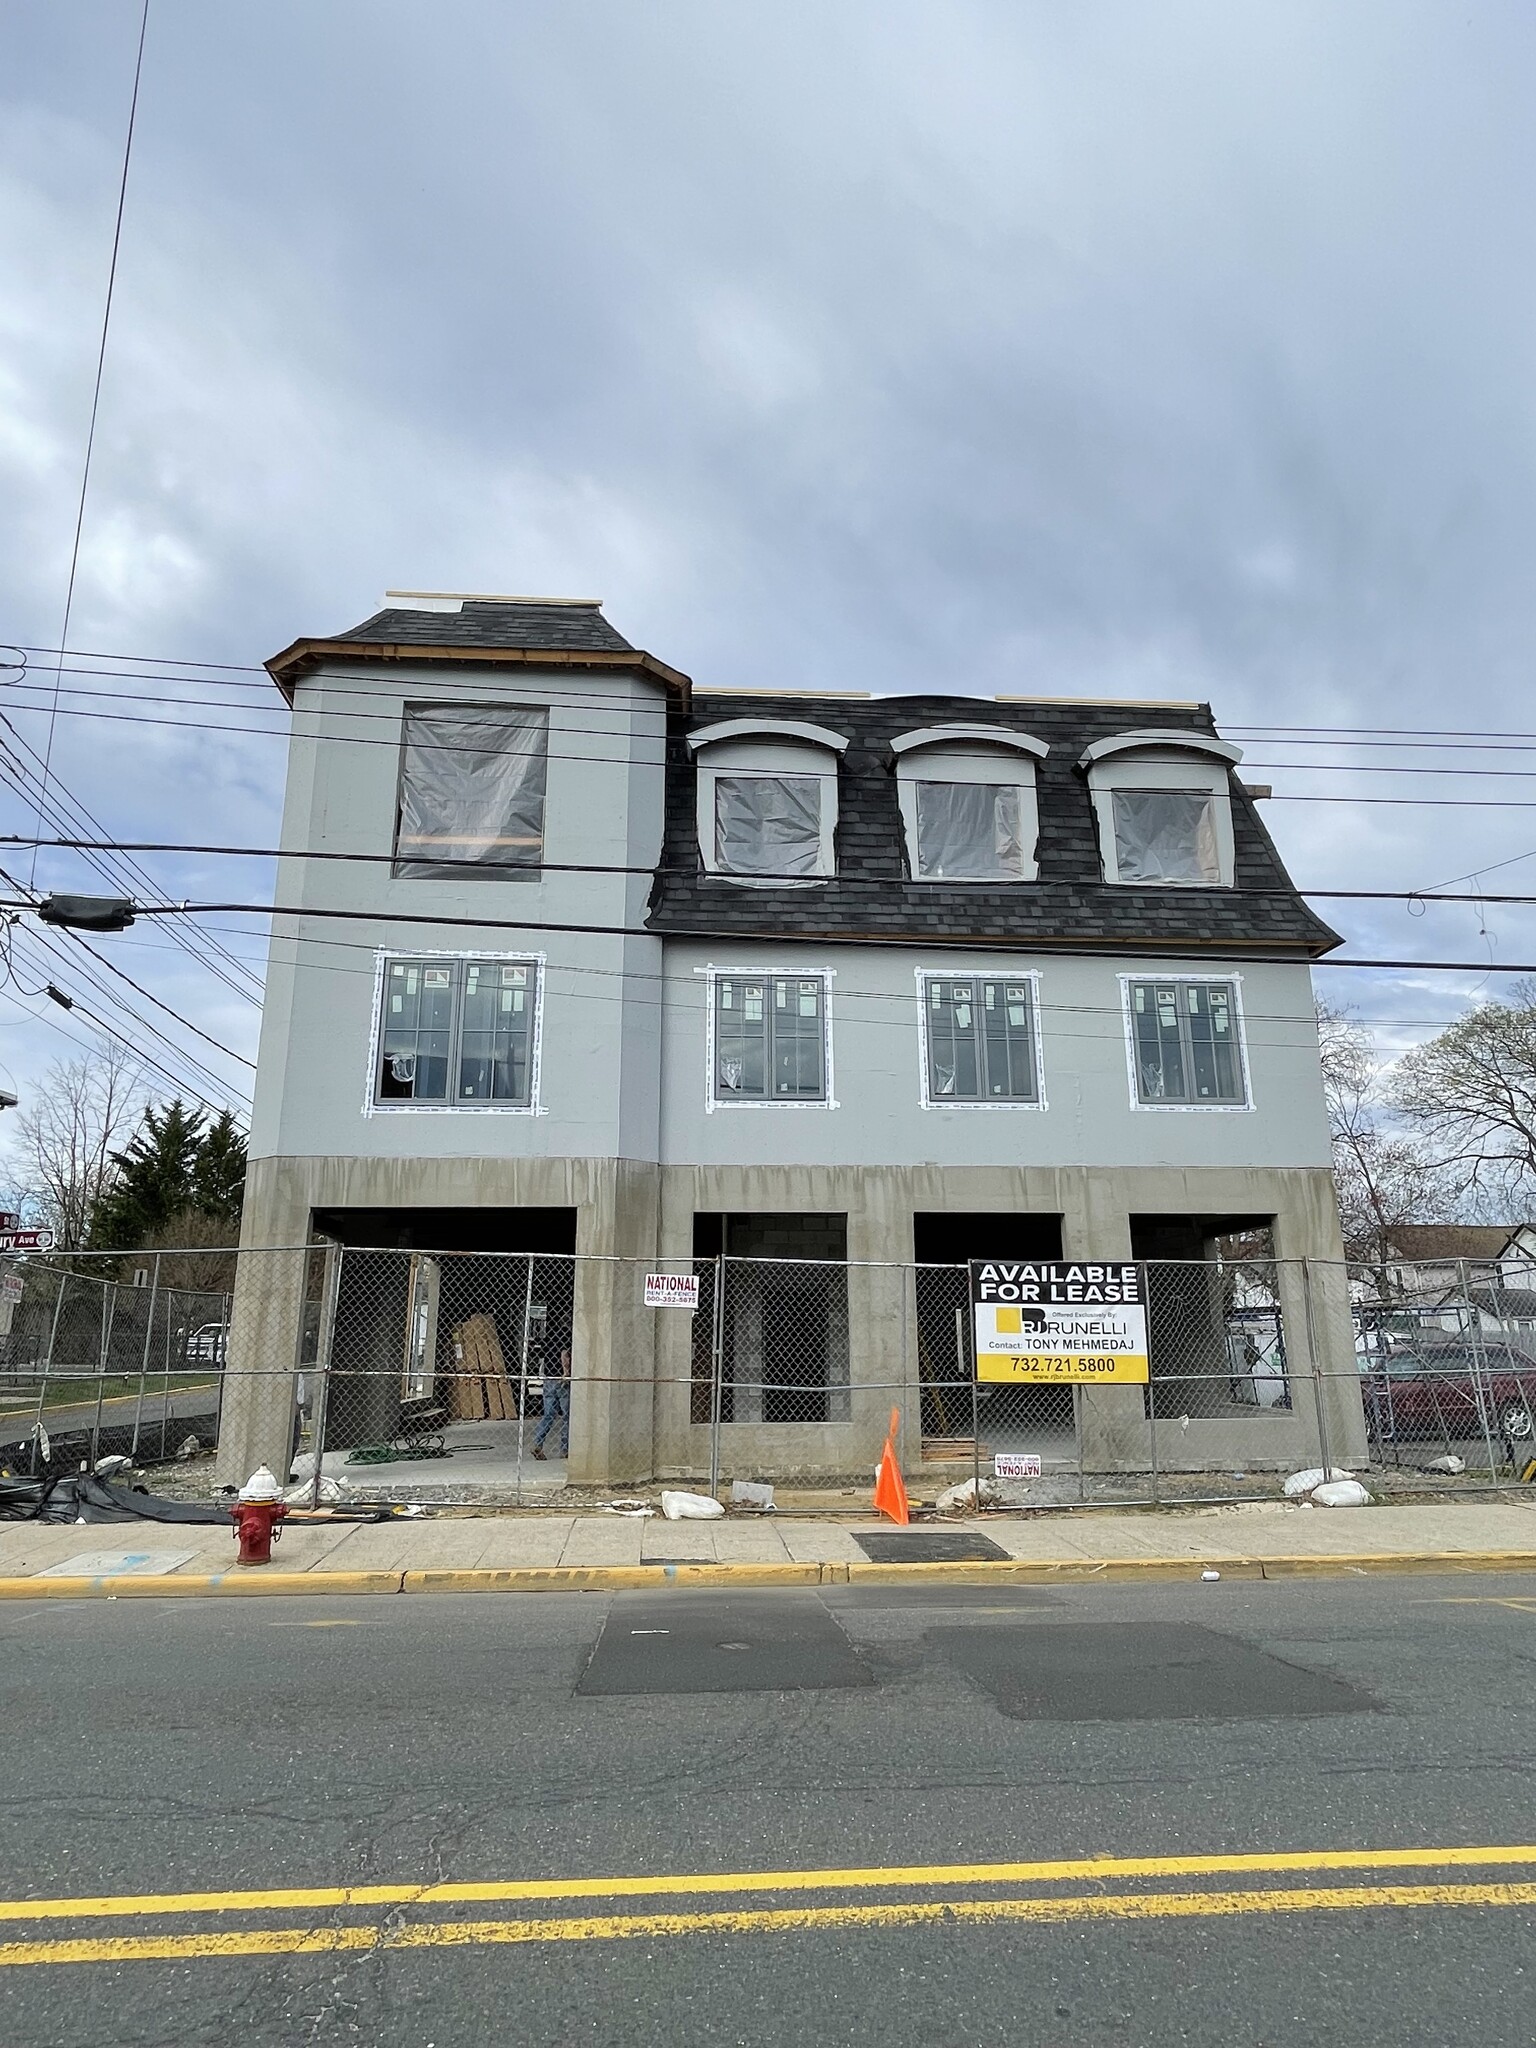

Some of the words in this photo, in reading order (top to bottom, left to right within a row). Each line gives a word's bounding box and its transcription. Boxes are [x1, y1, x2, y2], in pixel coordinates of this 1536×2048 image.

[19, 1235, 35, 1244] Ave
[979, 1264, 1137, 1283] AVAILABLE
[647, 1275, 697, 1291] NATIONAL
[980, 1283, 1041, 1301] FOR
[1050, 1284, 1139, 1302] LEASE
[988, 1341, 1023, 1350] Contact:
[1024, 1338, 1059, 1350] TONY
[1062, 1339, 1134, 1350] MEHMEDAJ
[1011, 1357, 1115, 1372] 732.721.5800
[1032, 1373, 1096, 1381] www.rjbrunelli.com
[997, 1465, 1039, 1476] NATIONAL
